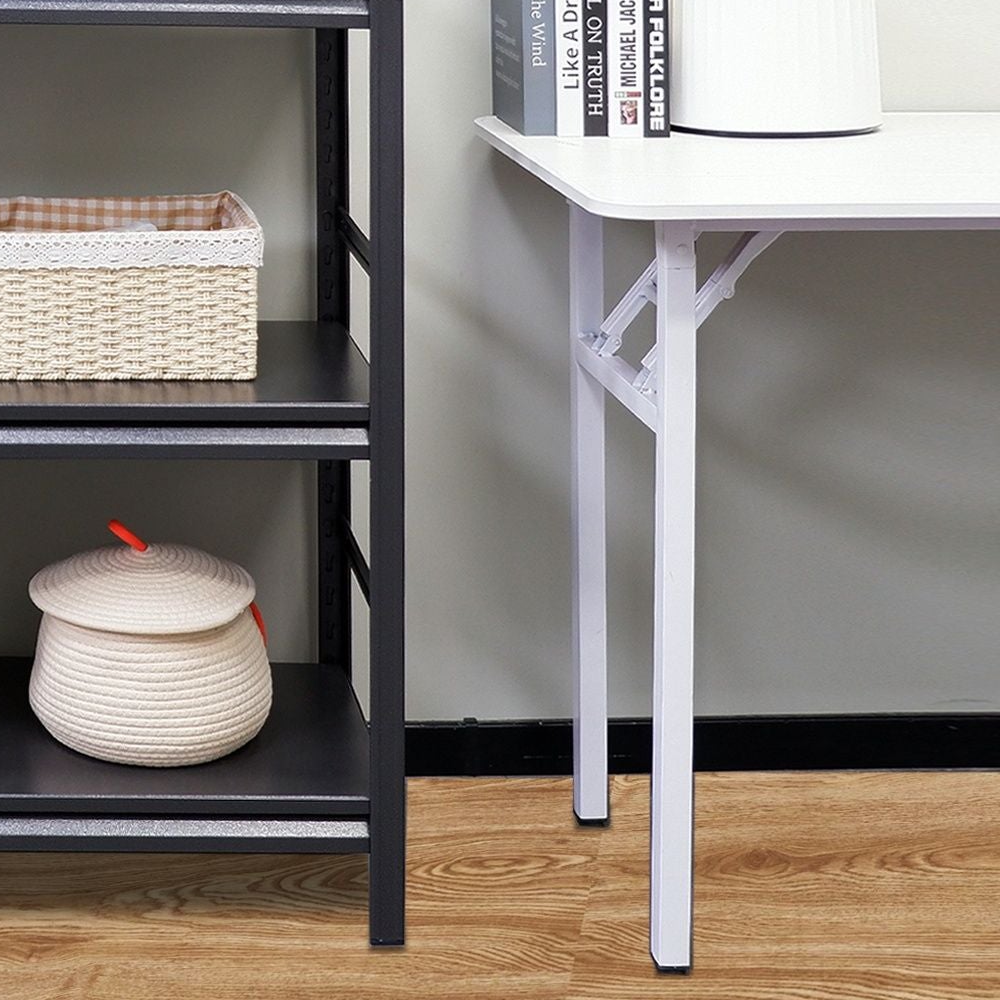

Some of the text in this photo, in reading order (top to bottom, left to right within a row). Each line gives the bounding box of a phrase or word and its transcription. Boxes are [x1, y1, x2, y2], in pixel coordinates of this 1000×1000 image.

[532, 23, 546, 67] Wind
[563, 29, 578, 42] A
[587, 17, 602, 43] ON
[563, 48, 579, 89] Like
[620, 29, 637, 87] MICHAEL
[649, 18, 664, 130] FOLKLORE
[587, 51, 603, 116] TRUTH
